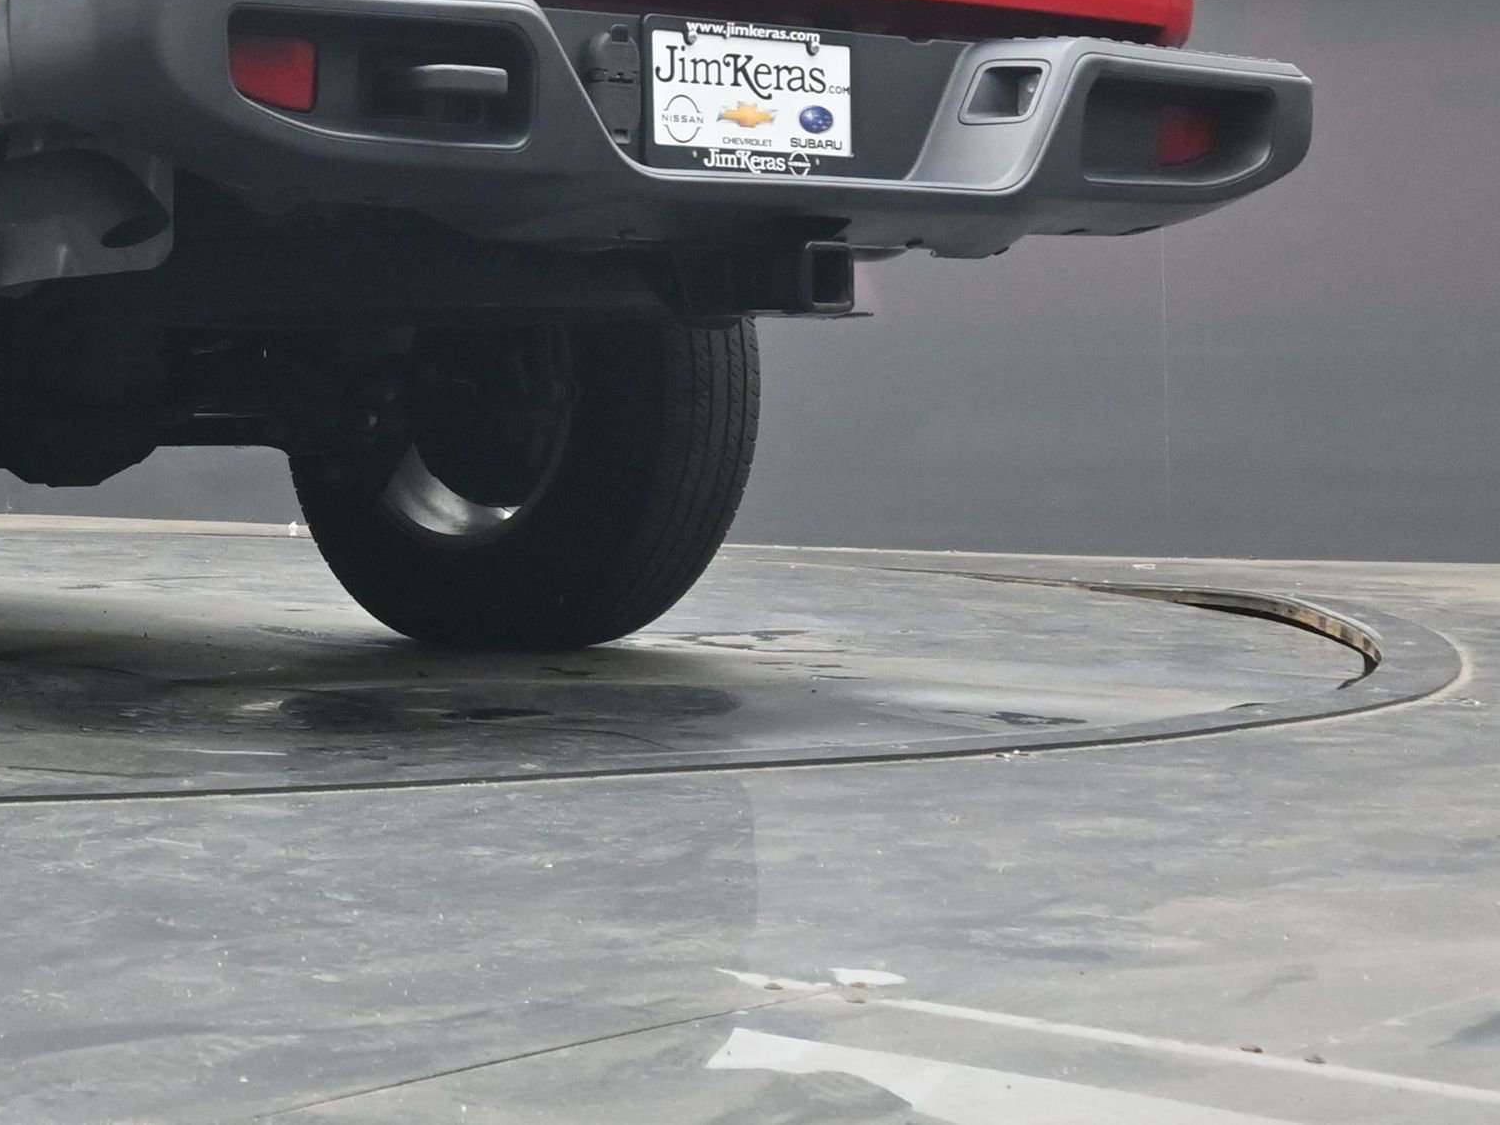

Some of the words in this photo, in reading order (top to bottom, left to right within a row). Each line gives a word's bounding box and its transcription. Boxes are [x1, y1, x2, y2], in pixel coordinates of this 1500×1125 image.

[686, 21, 820, 43] www.jimkeras.com
[661, 114, 704, 124] NISSAN
[722, 136, 773, 148] CHEVROLET
[790, 137, 842, 151] SUBARU
